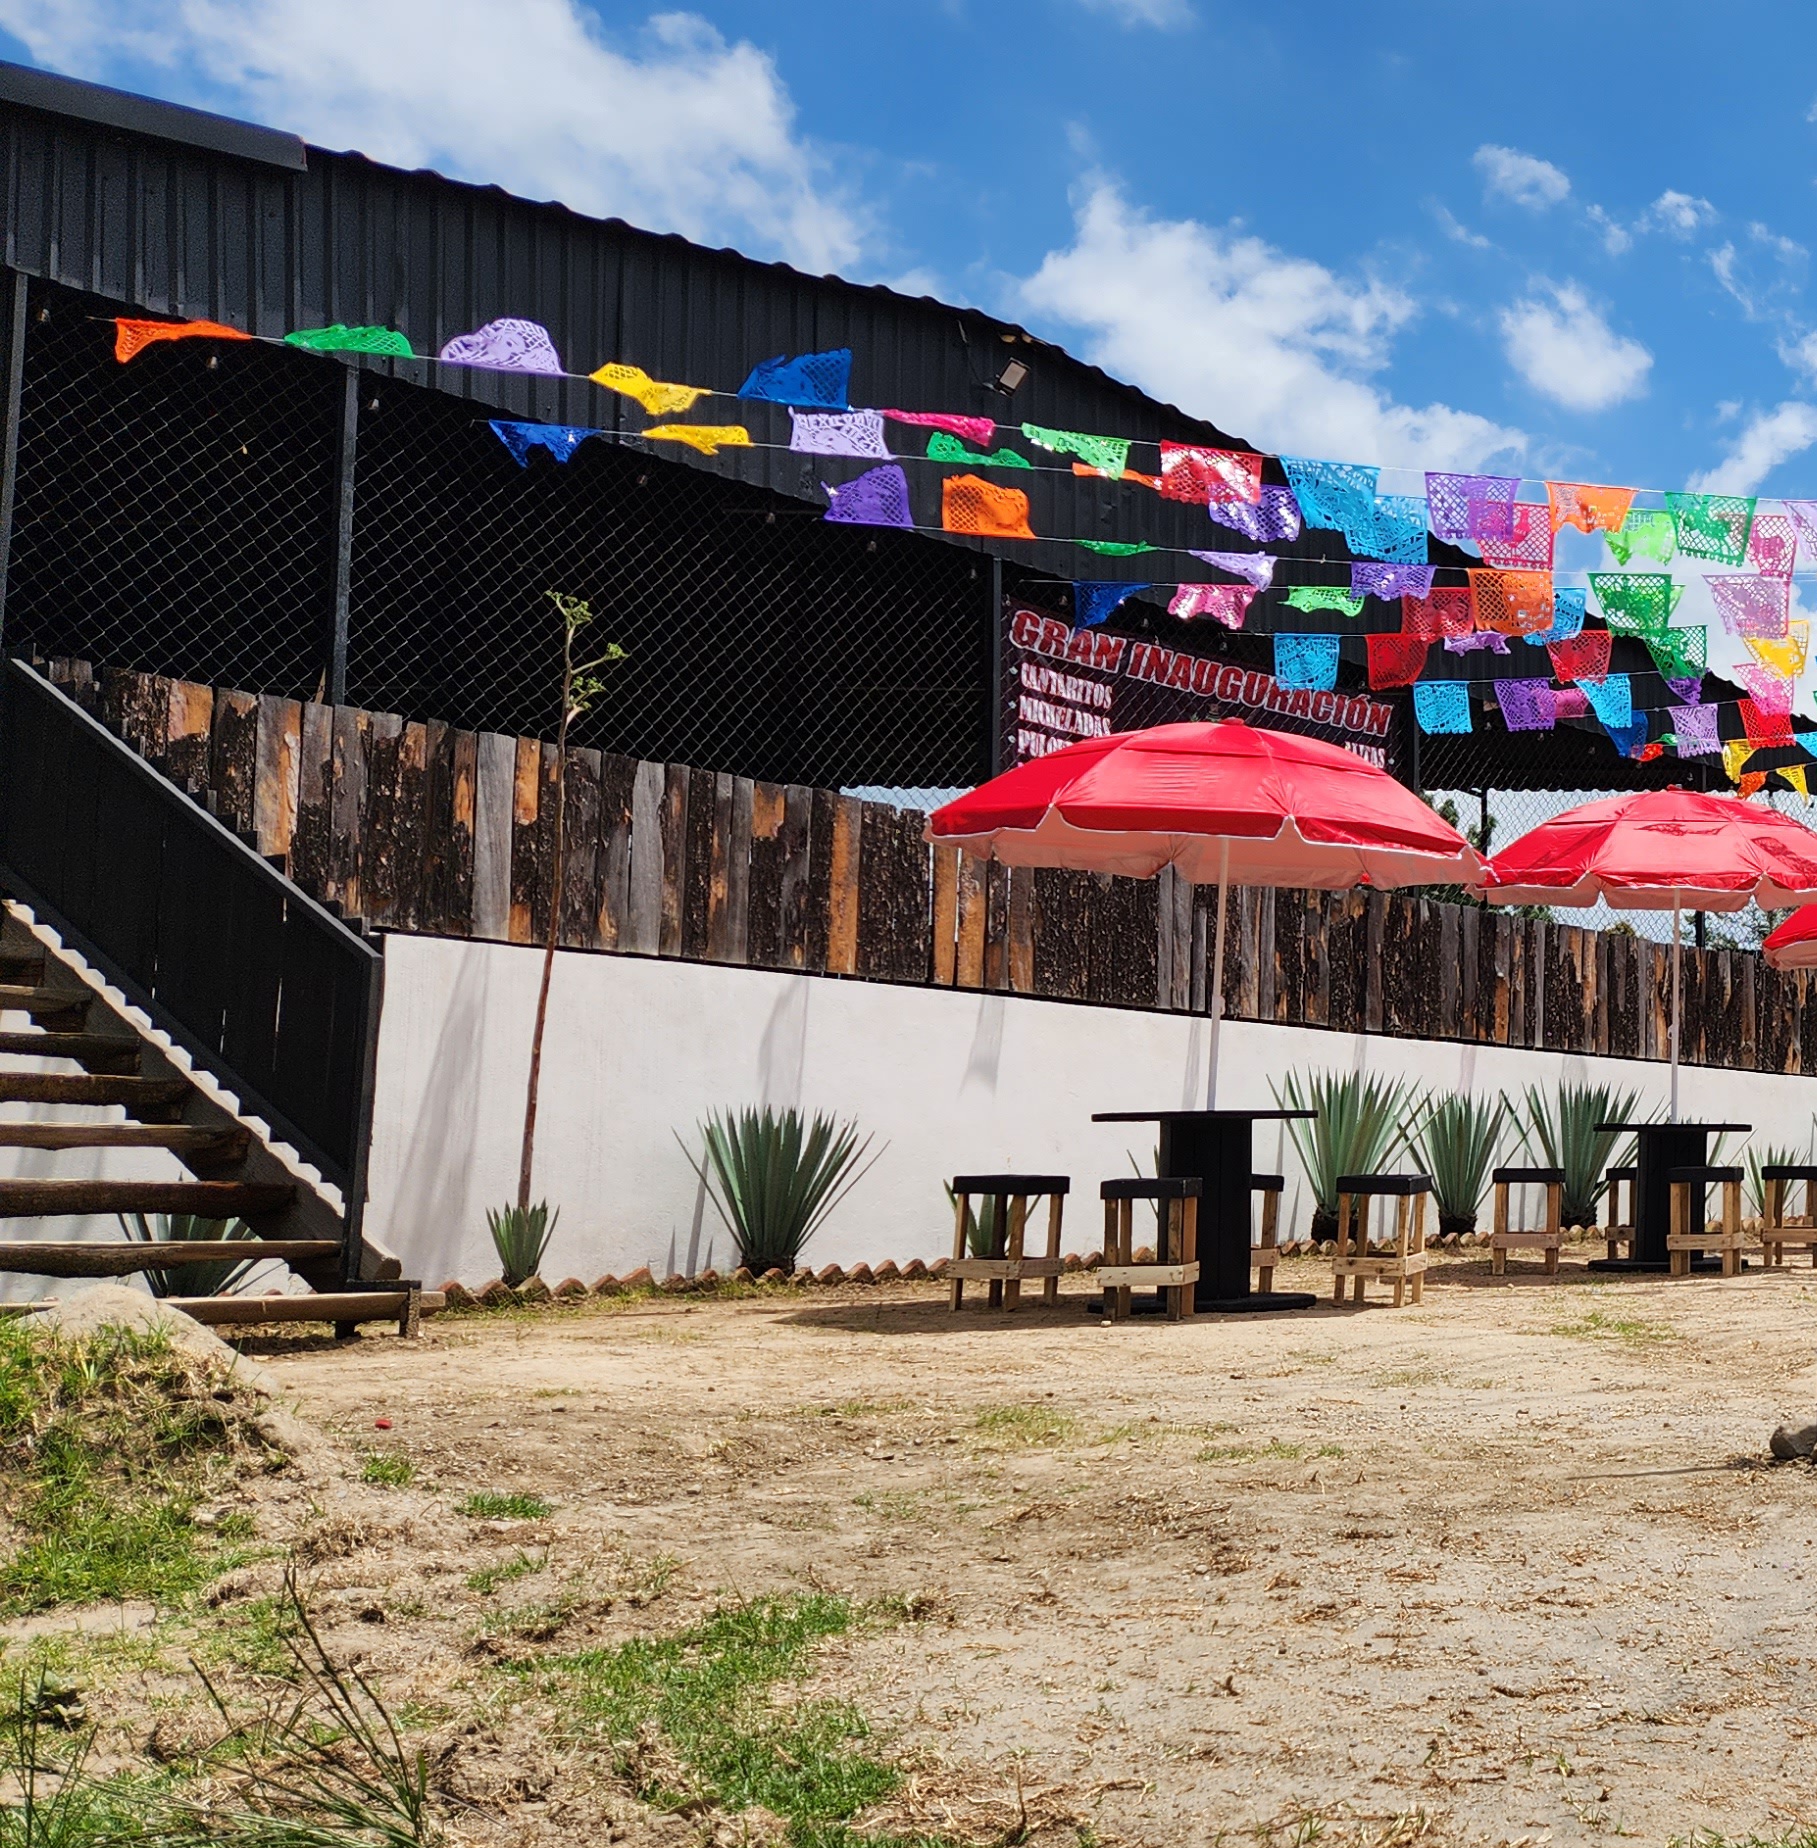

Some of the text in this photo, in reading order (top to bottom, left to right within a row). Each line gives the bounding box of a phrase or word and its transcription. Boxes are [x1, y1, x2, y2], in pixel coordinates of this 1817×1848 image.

[1009, 610, 1394, 738] GRAN INAUGURACIÓN
[1020, 662, 1113, 709] CANTARITOS
[1018, 695, 1111, 738] MICHELADAS
